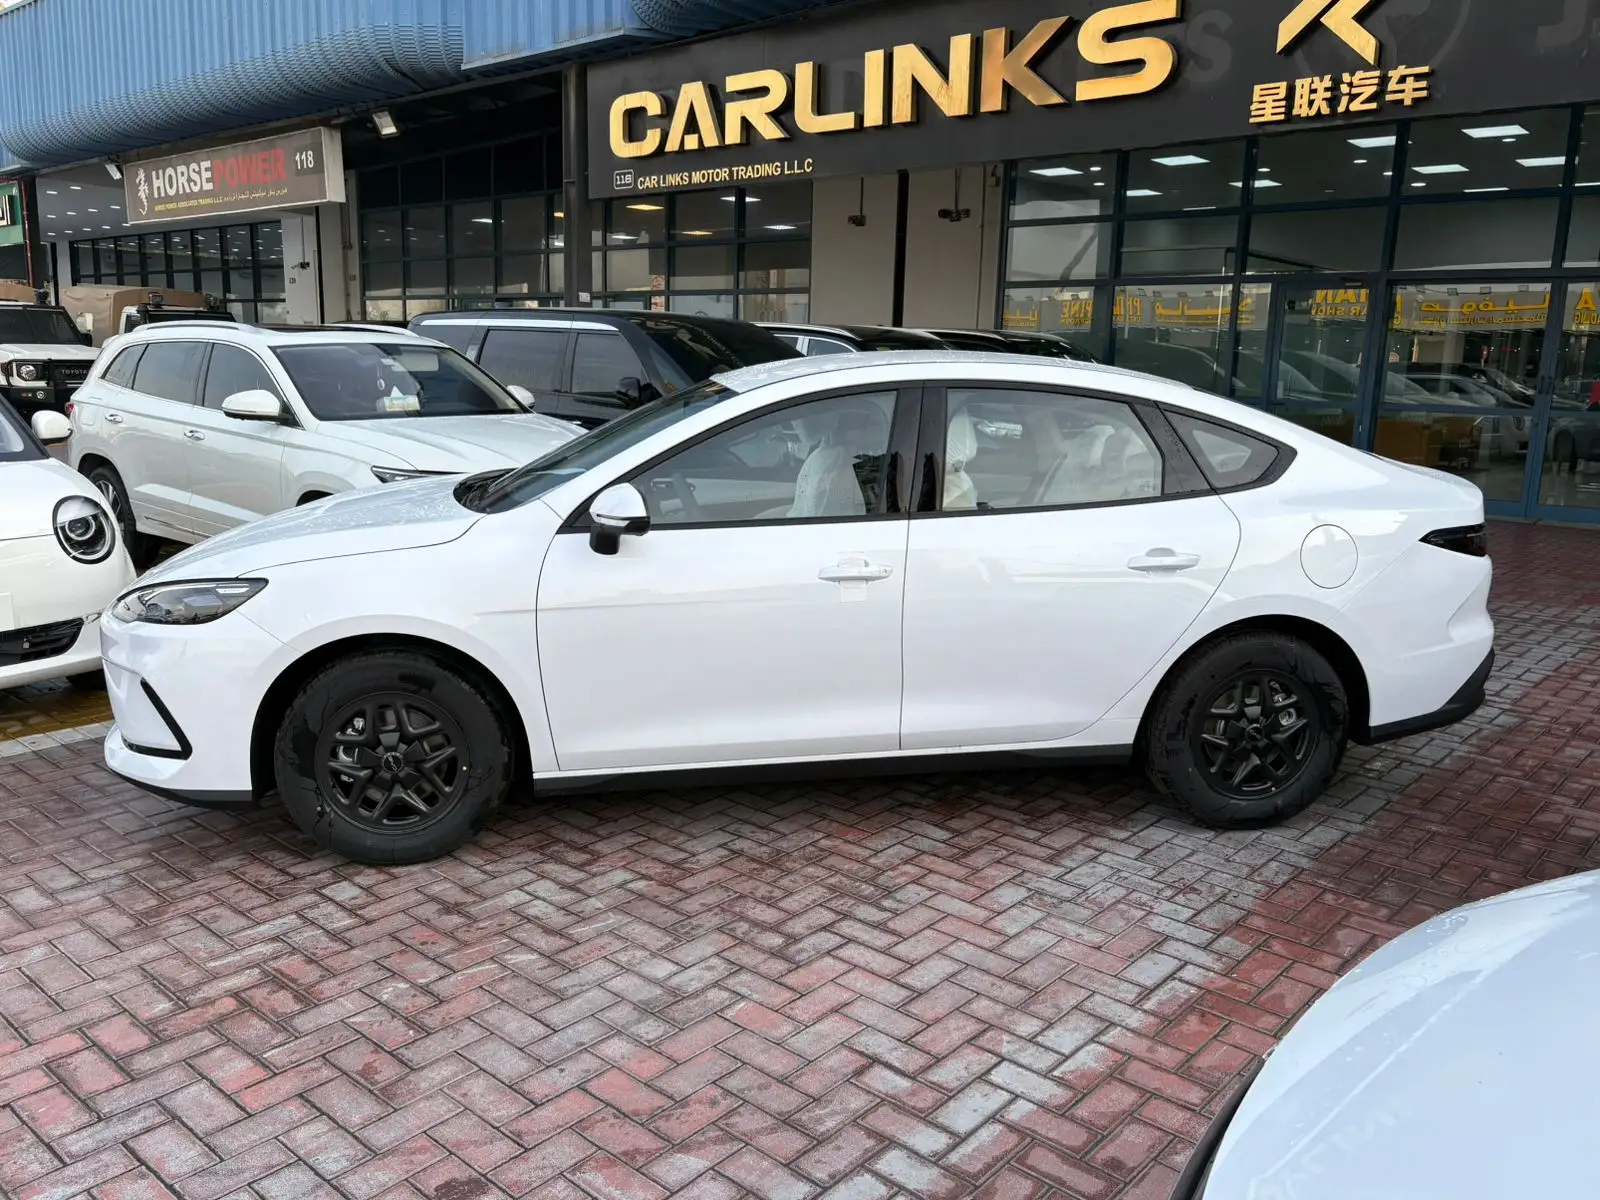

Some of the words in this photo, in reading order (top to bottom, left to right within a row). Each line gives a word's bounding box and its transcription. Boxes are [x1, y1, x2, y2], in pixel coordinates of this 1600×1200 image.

[608, 0, 1182, 160] CARLINKS
[1249, 65, 1431, 124] 星联汽车
[295, 150, 315, 170] 118
[637, 176, 658, 190] CAR
[660, 172, 690, 187] LINKS
[691, 168, 729, 184] MOTOR
[731, 162, 782, 180] TRADING
[784, 157, 813, 174] L.L.C
